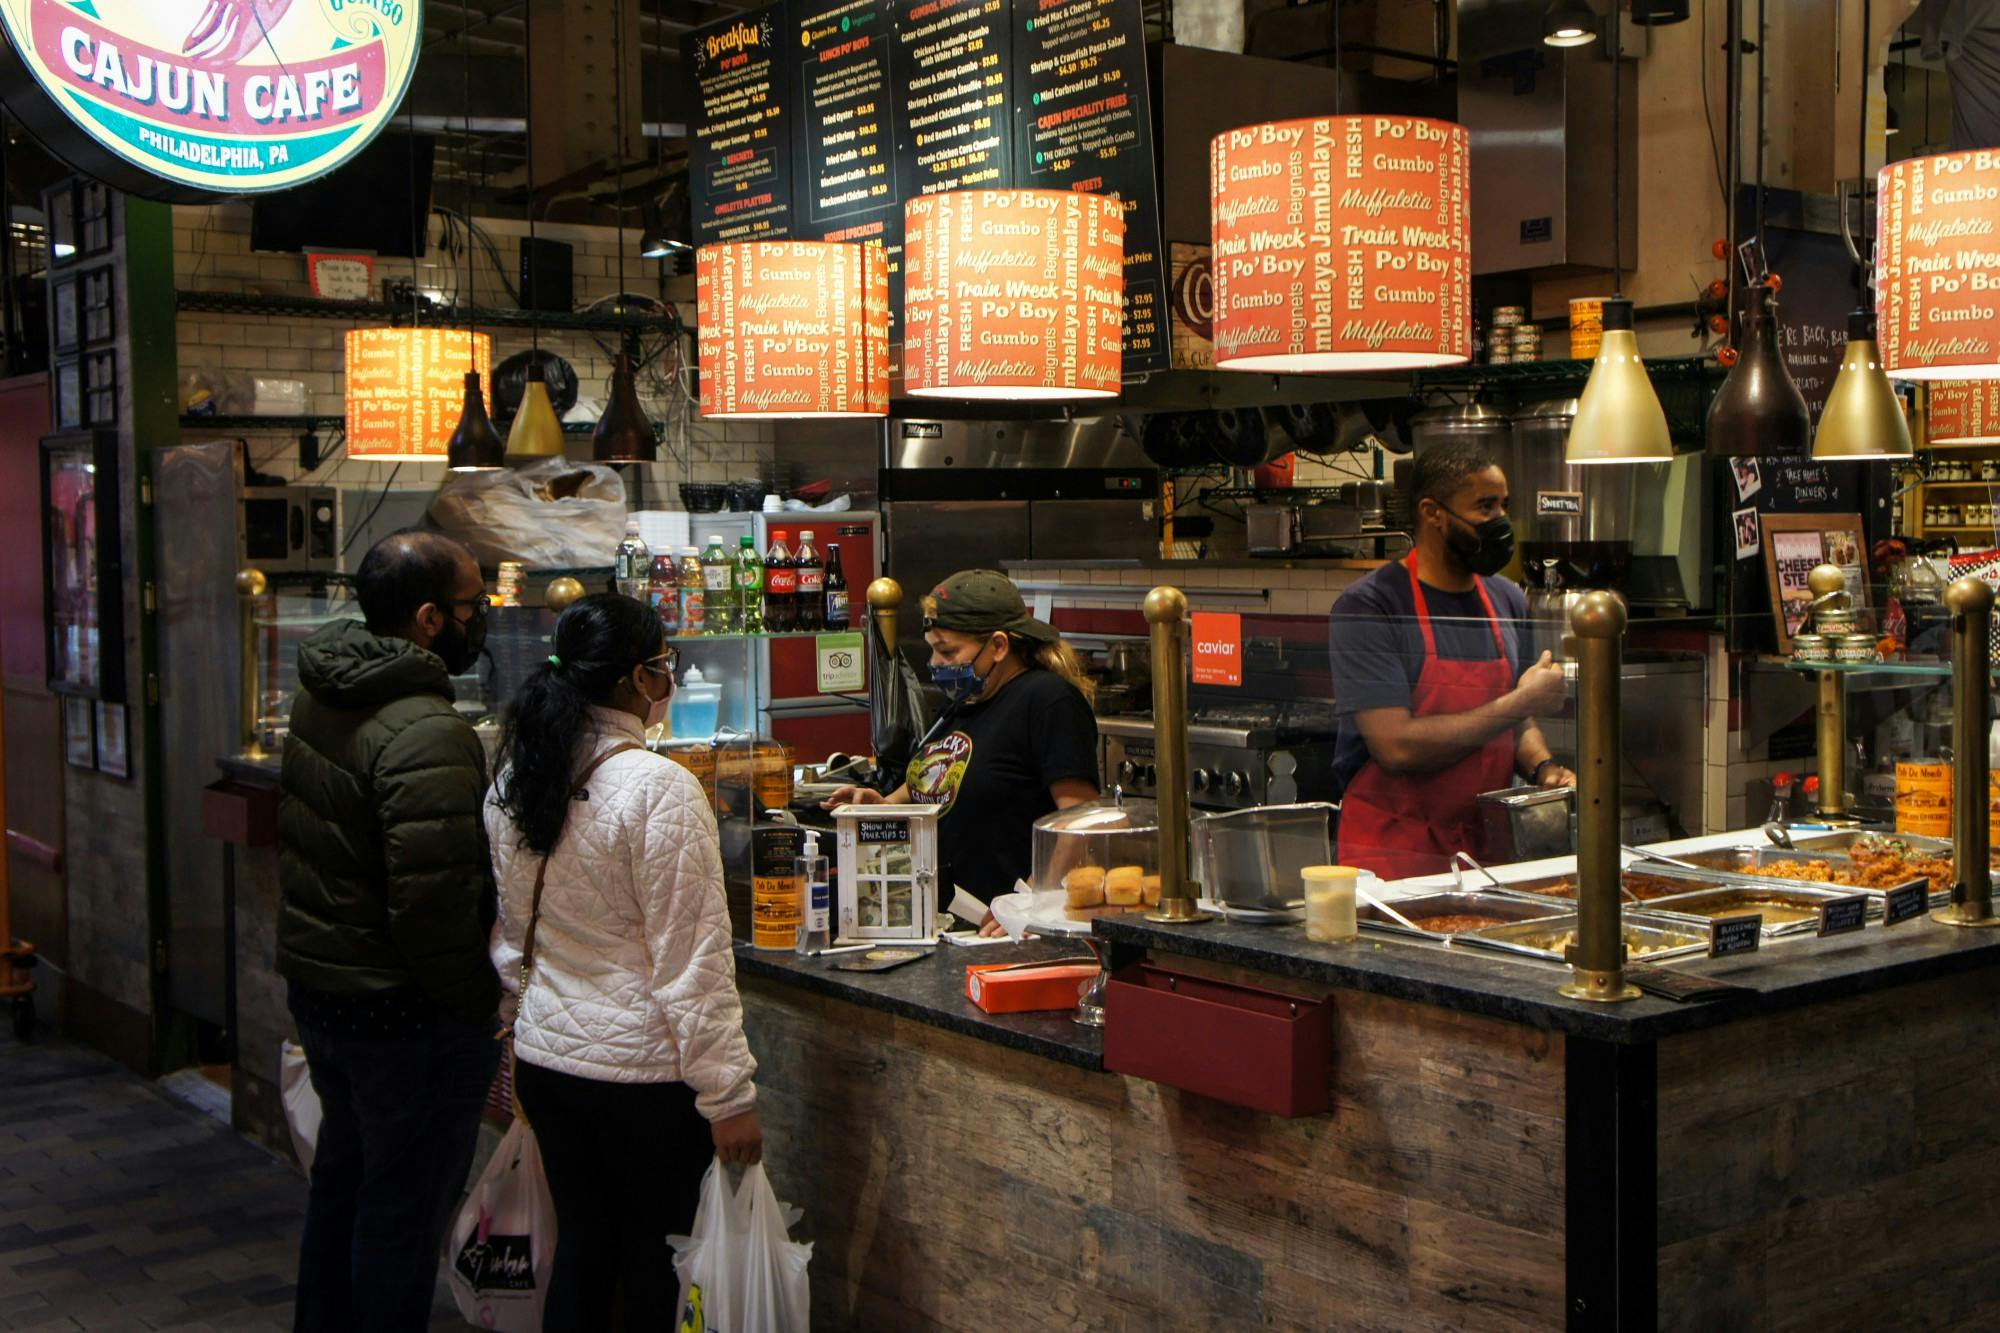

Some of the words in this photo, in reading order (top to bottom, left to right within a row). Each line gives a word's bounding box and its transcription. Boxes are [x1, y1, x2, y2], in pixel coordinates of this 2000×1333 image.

[916, 23, 937, 37] Gumbo
[937, 17, 951, 30] with
[950, 11, 968, 25] White
[968, 7, 980, 19] Rice
[1033, 13, 1050, 29] Fried
[1050, 9, 1063, 22] Mac
[1063, 8, 1069, 18] &
[1069, 1, 1092, 17] Cheese
[706, 22, 759, 59] Breakfast
[913, 44, 935, 59] Chicken
[968, 25, 990, 40] Gumbo
[1041, 37, 1059, 51] Topped
[1058, 34, 1070, 45] with
[1070, 28, 1088, 41] Gumbo
[1092, 17, 1110, 32] $6.25
[819, 46, 841, 62] LUNCH
[920, 55, 934, 68] with
[934, 49, 951, 63] White
[951, 46, 963, 57] Rice
[1030, 60, 1054, 75] Shrimp
[1054, 57, 1059, 67] &
[1060, 47, 1089, 65] Crawfish
[1088, 42, 1107, 56] Pasta
[1107, 33, 1126, 50] Salad
[60, 26, 227, 119] CAJUN
[243, 62, 362, 122] CAFE
[909, 75, 931, 91] Chicken
[936, 68, 957, 82] Shrimp
[957, 61, 978, 75] Gumbo
[1059, 63, 1077, 76] $4.50
[1080, 56, 1098, 70] $9.75
[1040, 89, 1054, 103] Mini
[1054, 79, 1083, 97] Corbread
[1084, 75, 1098, 87] Loaf
[1103, 69, 1120, 83] $1.50
[836, 109, 854, 123] Oyster
[1037, 111, 1062, 129] CAJUN
[1062, 100, 1105, 122] SPECIALITY
[1105, 93, 1128, 109] FRIES
[923, 132, 935, 144] Red
[935, 128, 952, 141] Beans
[957, 123, 970, 135] Rice
[1082, 138, 1102, 152] Topped
[1101, 135, 1114, 146] with
[1114, 130, 1135, 143] Gumbo
[1231, 127, 1259, 151] Po'
[1261, 125, 1304, 148] Boy
[1375, 118, 1413, 138] Po'
[1415, 120, 1449, 149] Boy
[139, 127, 265, 169] PHILADELPHIA,
[269, 144, 289, 164] PA
[839, 149, 858, 162] Catfish
[1043, 150, 1054, 161] THE
[1054, 145, 1079, 158] ORIGINAL
[1100, 146, 1117, 159] $5.95
[1346, 118, 1362, 179] FRESH
[1054, 159, 1071, 171] $4.50
[1230, 160, 1282, 182] Gumbo
[1373, 153, 1435, 173] Gumbo
[922, 183, 936, 195] Soup
[937, 180, 945, 190] du
[962, 170, 983, 185] Market
[983, 168, 999, 180] Price
[1072, 176, 1102, 192] SWEETS
[1287, 150, 1306, 225] Beignets
[1309, 120, 1336, 247] Jambalaya
[1911, 160, 1925, 215] FRESH
[1933, 154, 1972, 176] Po'
[983, 191, 1017, 209] Po'
[1020, 191, 1060, 214] Boy
[1931, 185, 1998, 205] Gumbo
[961, 192, 973, 243] FRESH
[981, 220, 1041, 236] Gumbo
[1888, 164, 1907, 279] Jambalaya
[936, 195, 953, 300] Jambalaya
[1043, 217, 1059, 279] Beignets
[1340, 224, 1398, 246] Train
[1402, 225, 1450, 250] Wreck
[760, 243, 790, 257] Po'
[792, 243, 827, 262] Boy
[1135, 252, 1152, 264] Price
[1906, 252, 1952, 275] Train
[741, 244, 753, 288] FRESH
[759, 268, 812, 281] Gumbo
[955, 280, 1002, 298] Train
[1005, 281, 1059, 300] Wreck
[1347, 250, 1364, 310] FRESH
[1135, 294, 1153, 305] $7.95
[1374, 285, 1436, 304] Gumbo
[1133, 308, 1151, 320] $7.95
[382, 330, 408, 343] Boy
[740, 321, 780, 336] Train
[783, 320, 830, 336] Wreck
[1137, 322, 1155, 334] $7.95
[1777, 323, 1798, 347] E'RE
[362, 348, 396, 359] Gumbo
[1132, 338, 1151, 350] $7.95
[1947, 389, 1969, 402] Boy
[1197, 639, 1235, 655] caviar
[861, 822, 883, 831] SHOW
